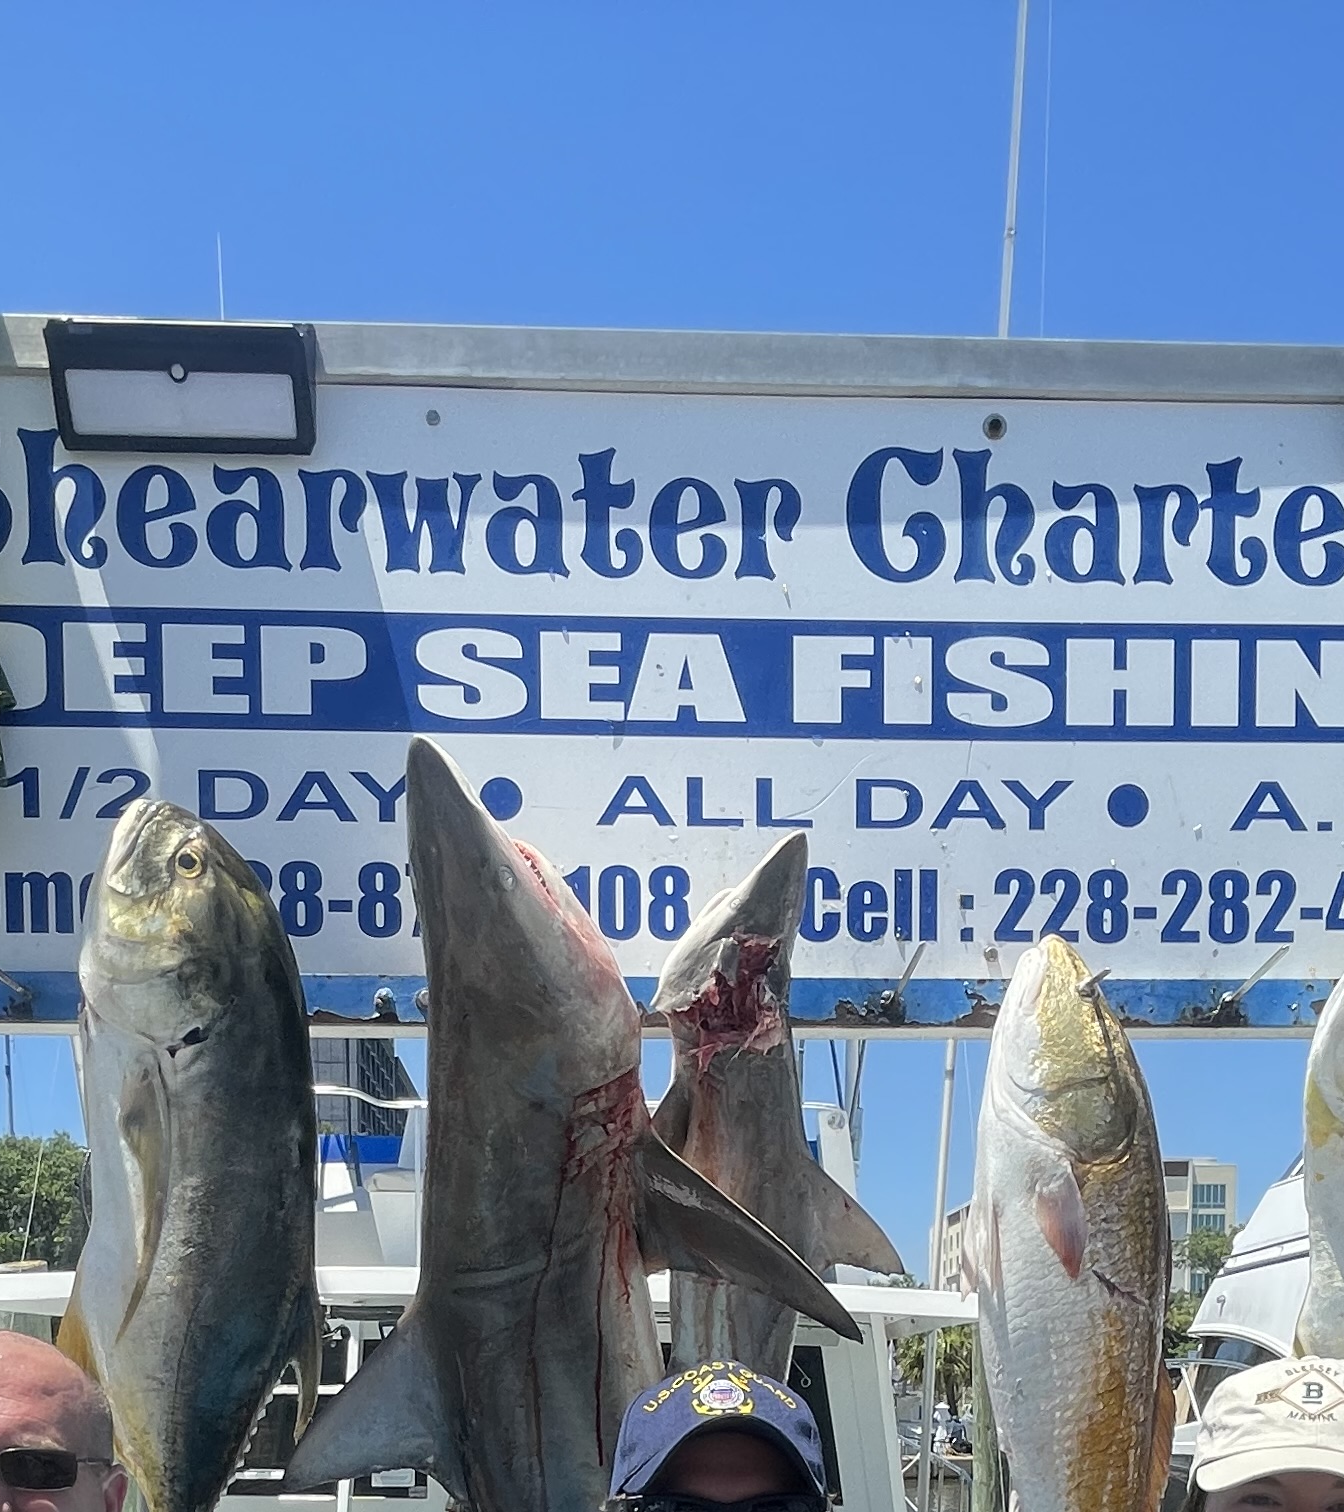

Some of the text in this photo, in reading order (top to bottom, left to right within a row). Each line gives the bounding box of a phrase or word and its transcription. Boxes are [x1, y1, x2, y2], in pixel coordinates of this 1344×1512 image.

[414, 627, 748, 724] SEA
[7, 766, 152, 820] 1/2
[197, 769, 407, 822] DAY
[596, 775, 814, 829] ALL
[855, 778, 1075, 830] DAY
[799, 866, 939, 943] Cell
[738, 1367, 798, 1410] GUARD
[1301, 1381, 1324, 1399] B
